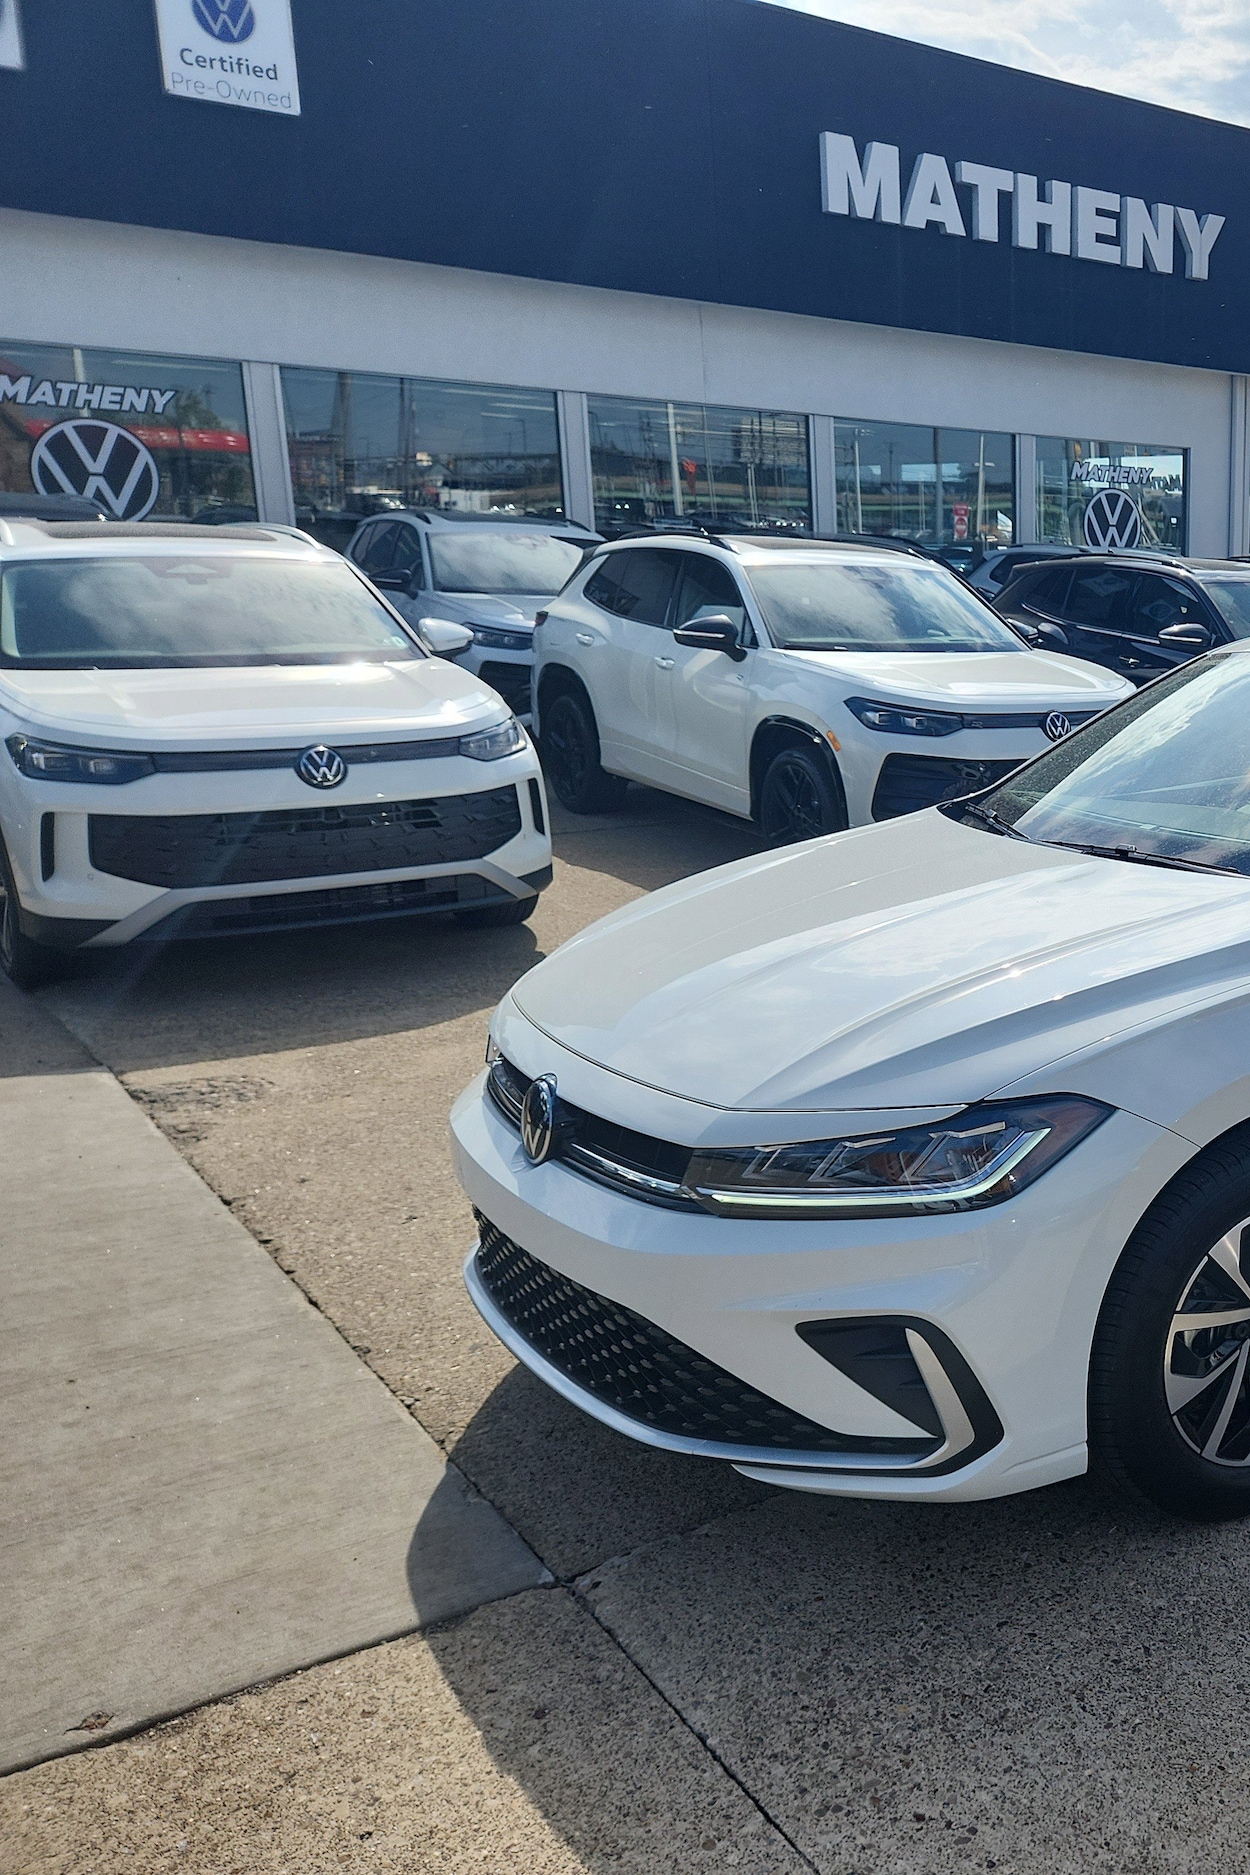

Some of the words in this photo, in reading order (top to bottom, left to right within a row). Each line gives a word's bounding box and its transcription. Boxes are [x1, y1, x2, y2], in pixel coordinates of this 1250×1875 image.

[179, 47, 278, 81] Certified
[171, 71, 292, 109] Pre-Owned
[819, 130, 1226, 281] MATHENY
[0, 374, 175, 414] MATHENY
[1071, 461, 1154, 484] MATHENY
